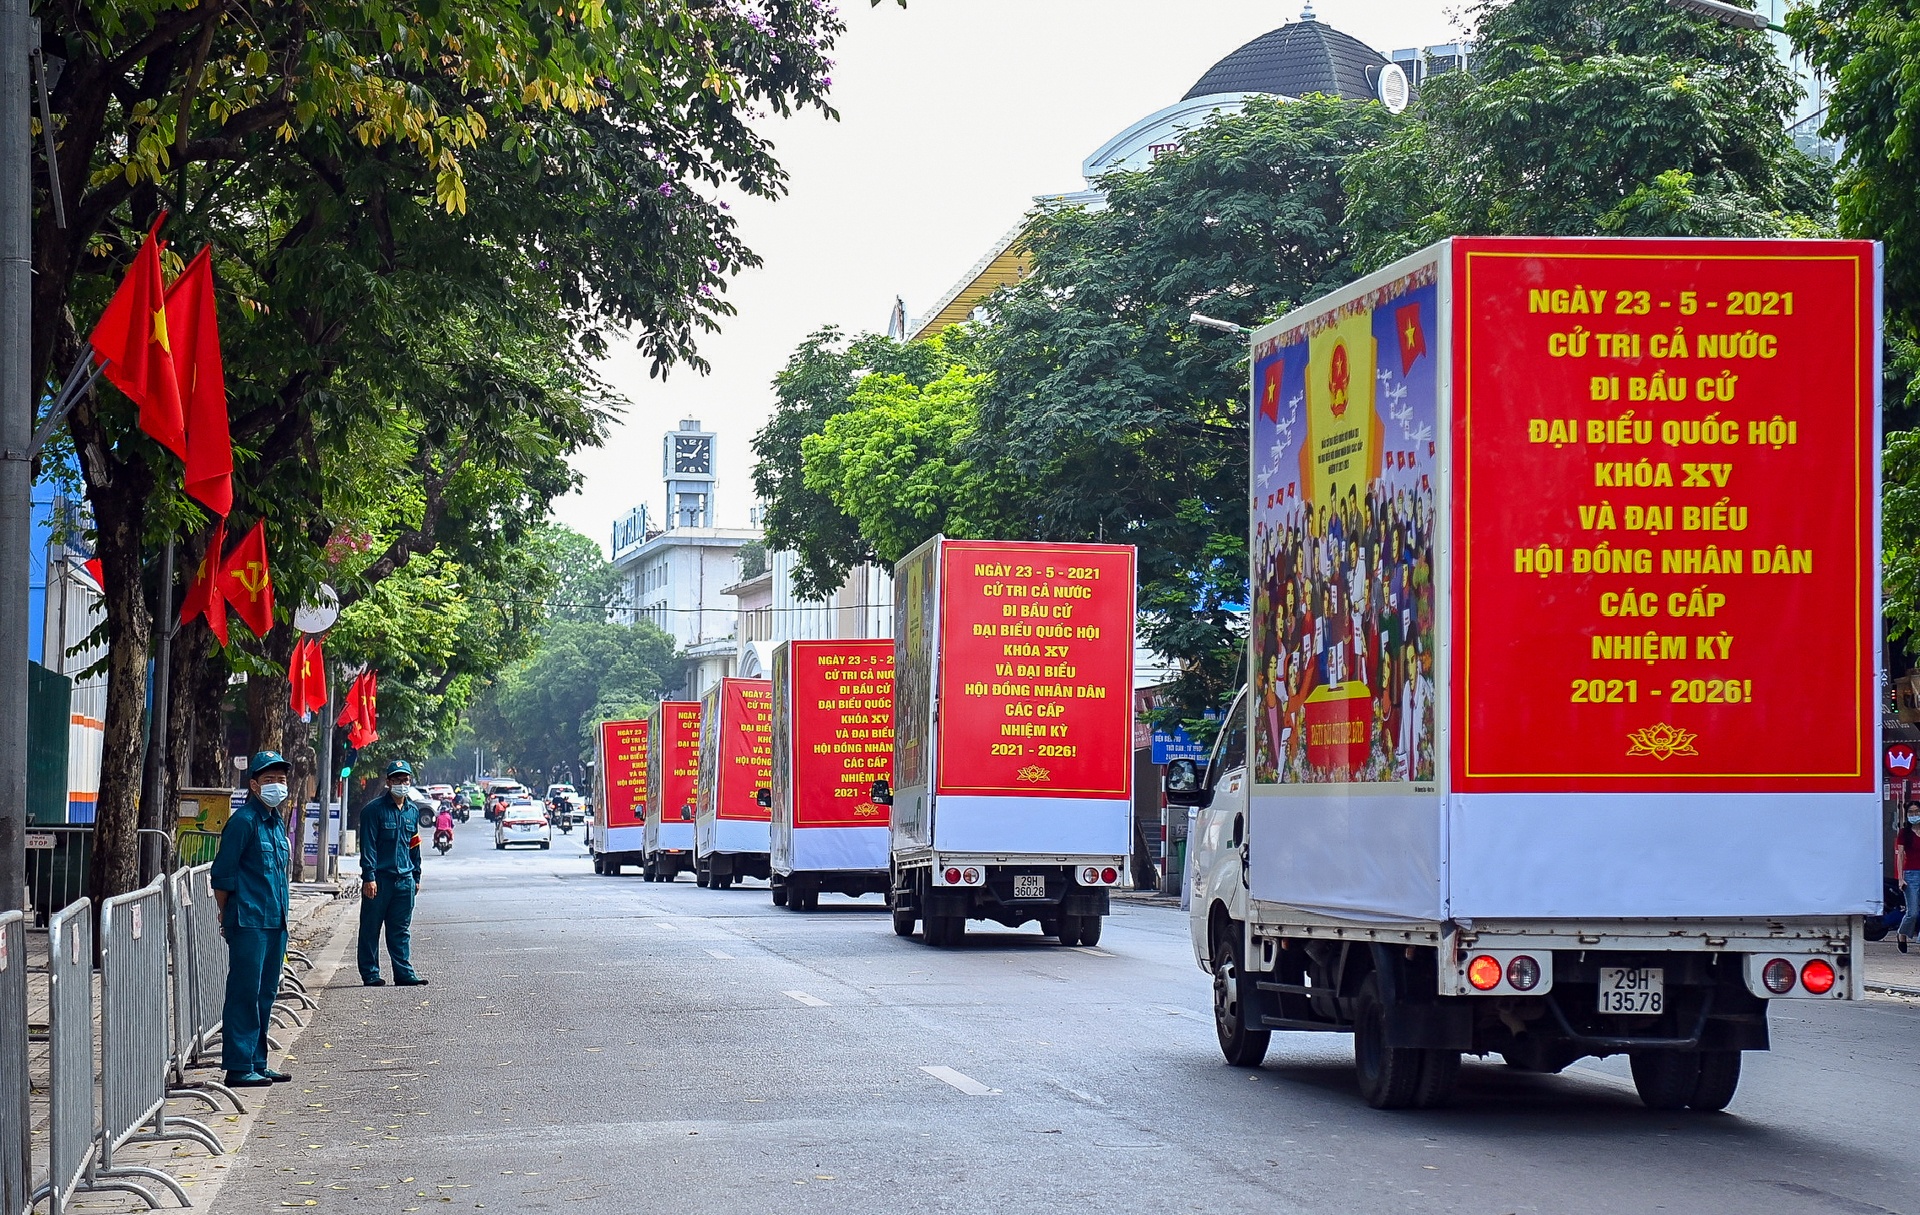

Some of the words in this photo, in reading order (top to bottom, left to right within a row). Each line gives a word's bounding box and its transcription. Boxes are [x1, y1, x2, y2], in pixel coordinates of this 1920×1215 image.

[1530, 285, 1607, 313] NGÀY
[1616, 291, 1650, 314] 23
[1681, 292, 1697, 314] 5
[1727, 292, 1792, 315] 2021
[1549, 326, 1590, 357] CỬ
[1596, 334, 1639, 357] TRI
[1651, 327, 1688, 358] CẢ
[1698, 330, 1776, 358] NƯỚC
[1591, 377, 1619, 400] ĐI
[1630, 370, 1686, 401] BẦU
[1697, 370, 1738, 401] CỬ
[1529, 419, 1577, 448] ĐẠI
[1588, 410, 1652, 444] BIỂU
[1663, 412, 1738, 446] QUỐC
[1749, 416, 1796, 449] HỘI
[1596, 458, 1673, 487] KHÓA
[1682, 464, 1732, 487] XV
[1579, 501, 1616, 529] VÀ
[1625, 506, 1672, 535] ĐẠI
[1683, 497, 1747, 530] BIỂU
[1515, 544, 1562, 578] HỘI
[1572, 541, 1651, 573] ĐỒNG
[1662, 545, 1742, 573] NHÂN
[1753, 545, 1812, 573] DÂN
[975, 562, 1012, 576] NGÀY
[1015, 566, 1032, 577] 23
[1046, 567, 1054, 578] 5
[1068, 568, 1099, 579] 2021
[984, 581, 1003, 596] CỬ
[1006, 585, 1027, 596] TRI
[1031, 582, 1049, 597] CẢ
[1054, 585, 1091, 598] NƯỚC
[1601, 588, 1657, 616] CÁC
[1669, 585, 1725, 617] CẤP
[1003, 605, 1016, 616] ĐI
[1021, 602, 1048, 617] BẦU
[1053, 603, 1073, 618] CỬ
[973, 624, 996, 638] ĐẠI
[1001, 621, 1031, 636] BIỂU
[1036, 623, 1072, 638] QUỐC
[1077, 625, 1099, 640] HỘI
[1004, 643, 1040, 656] KHÓA
[1045, 646, 1069, 657] XV
[1593, 631, 1686, 664] NHIỆM
[1697, 631, 1733, 659] KỲ
[819, 655, 845, 664] NGÀY
[848, 656, 860, 664] 23
[871, 656, 876, 664] 5
[825, 669, 840, 680] CỬ
[842, 671, 857, 679] TRI
[861, 668, 873, 679] CẢ
[877, 670, 895, 679] NƯ
[996, 662, 1013, 676] VÀ
[1017, 665, 1040, 679] ĐẠI
[1045, 661, 1075, 678] BIỂU
[840, 686, 850, 694] ĐI
[877, 683, 891, 693] CỬ
[965, 682, 988, 697] HỘI
[992, 681, 1030, 696] ĐỒNG
[1034, 684, 1072, 697] NHÂN
[1077, 685, 1105, 698] DÂN
[1572, 680, 1636, 702] 2021
[1672, 680, 1751, 703] 2026!
[819, 700, 835, 710] ĐẠI
[839, 697, 861, 708] BIỂU
[865, 697, 891, 709] QUỐC
[1006, 702, 1032, 716] CÁC
[1037, 702, 1064, 717] CẤP
[842, 713, 868, 723] KHÓA
[872, 714, 889, 723] XV
[756, 723, 772, 732] BIỂ
[836, 728, 849, 738] VÀ
[852, 730, 868, 739] ĐẠI
[872, 726, 894, 737] BIỂU
[1002, 723, 1046, 738] NHIỆM
[1051, 724, 1068, 737] KỲ
[814, 743, 830, 754] HỘI
[865, 742, 893, 752] NHÂN
[991, 744, 1022, 755] 2021
[1038, 745, 1076, 757] 2026!
[844, 757, 864, 768] CÁC
[868, 756, 887, 767] CẤP
[842, 772, 874, 784] NHIỆM
[835, 789, 857, 797] 2021
[1021, 876, 1038, 886] 29H
[1015, 886, 1044, 897] 360.28
[1614, 969, 1649, 990] 29H
[1603, 991, 1661, 1012] 135.78
